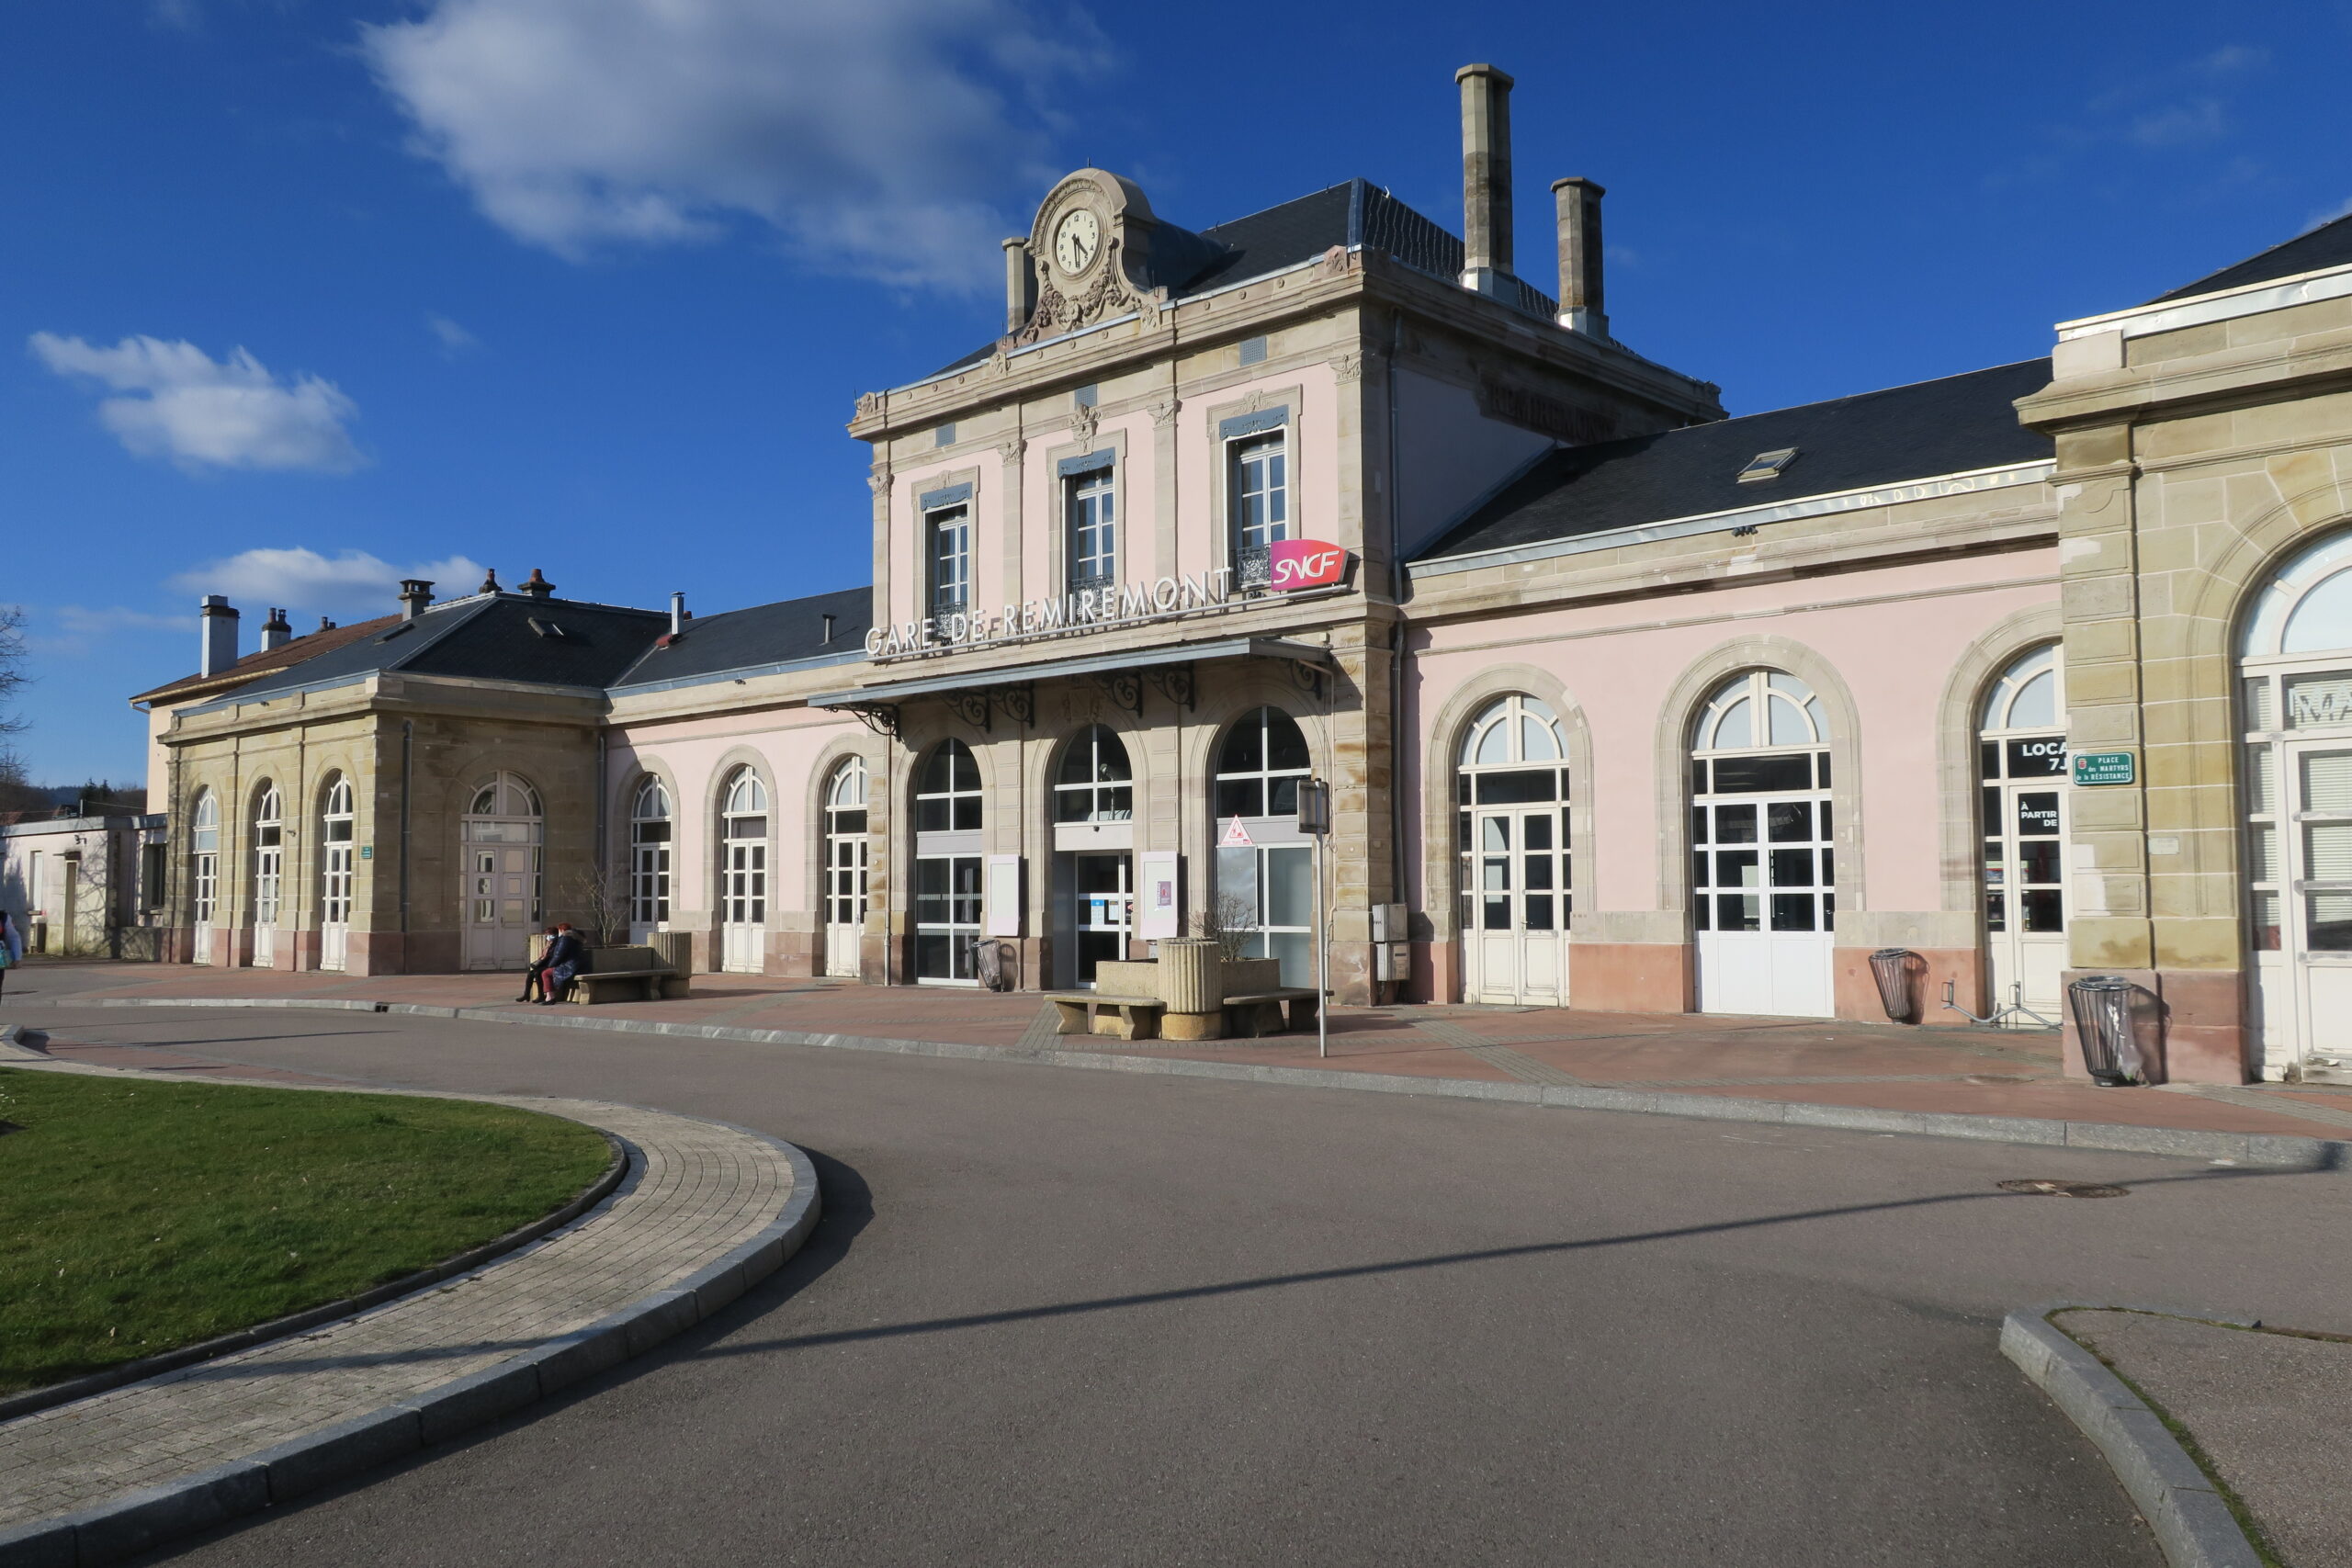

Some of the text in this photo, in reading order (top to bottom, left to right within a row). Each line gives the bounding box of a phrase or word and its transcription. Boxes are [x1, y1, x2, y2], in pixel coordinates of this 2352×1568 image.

[1273, 550, 1340, 583] SNCF
[865, 567, 1233, 655] GARE DE REMIREMONT
[2020, 801, 2029, 810] À
[2020, 810, 2057, 818] PARTIR
